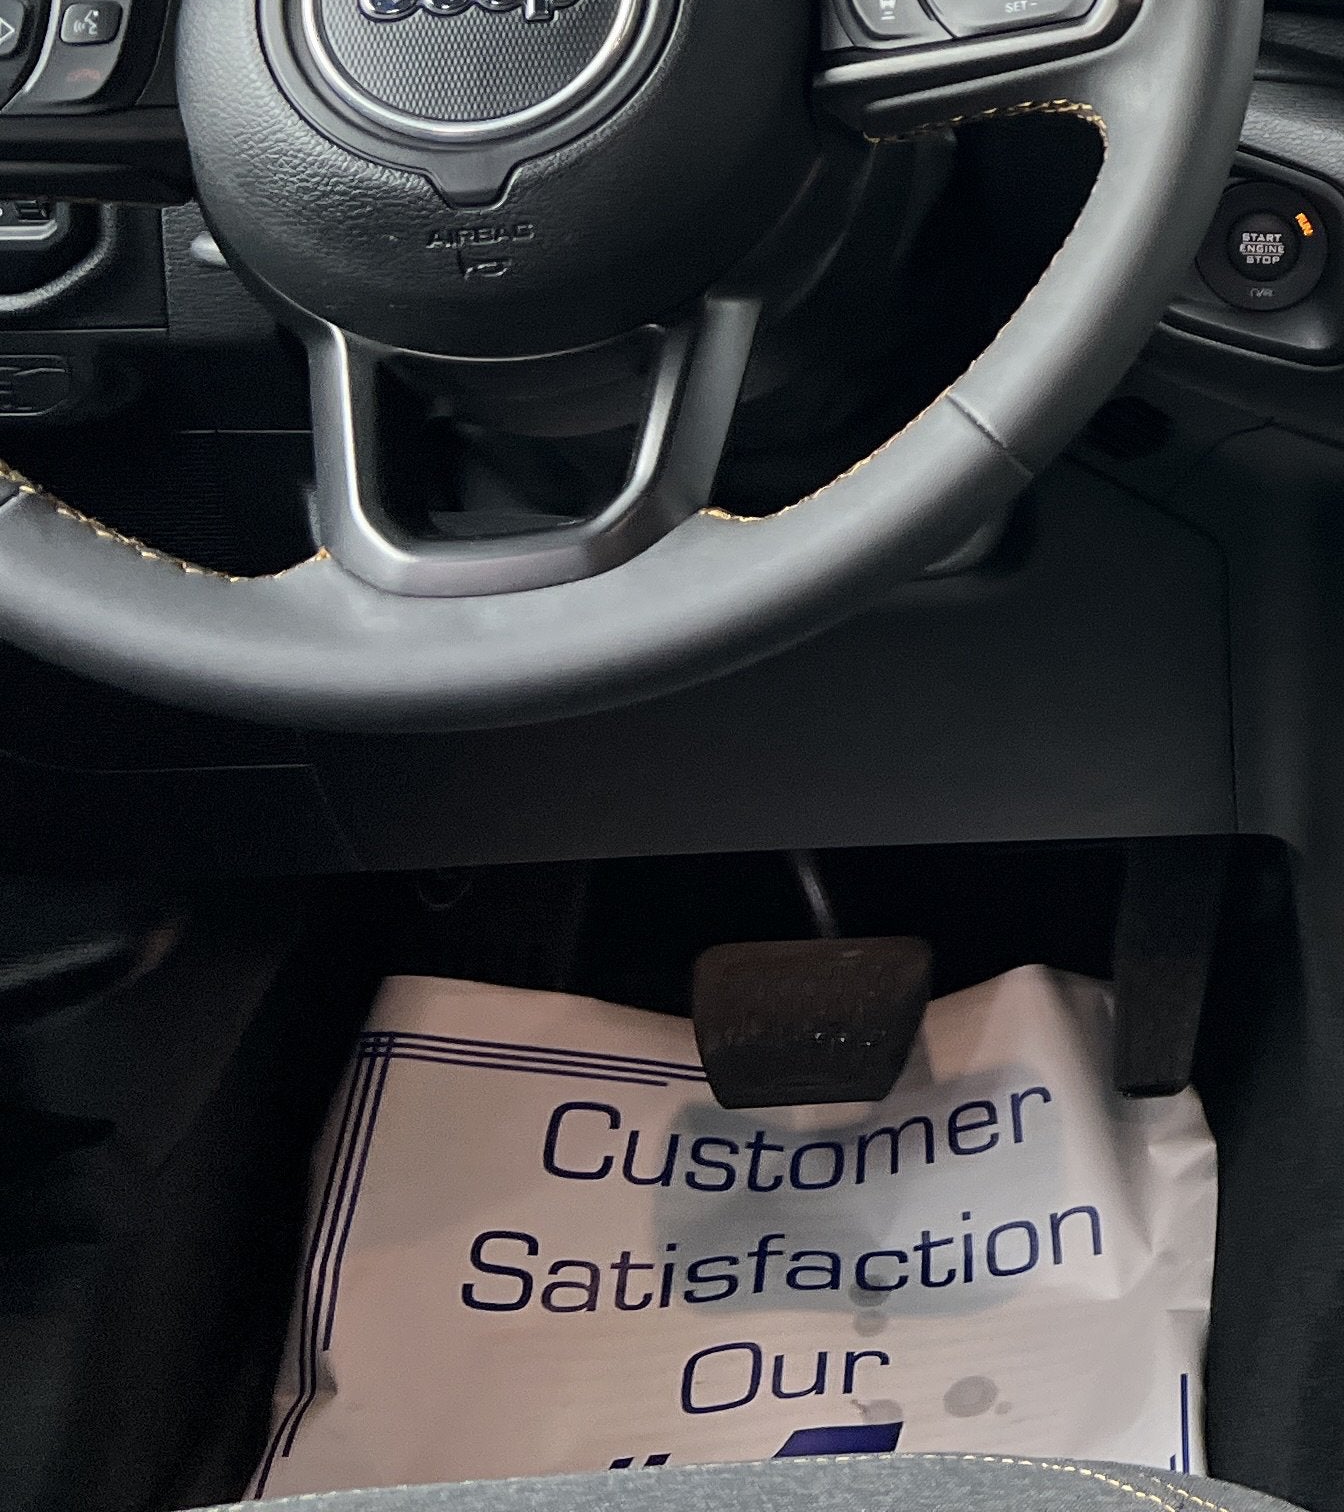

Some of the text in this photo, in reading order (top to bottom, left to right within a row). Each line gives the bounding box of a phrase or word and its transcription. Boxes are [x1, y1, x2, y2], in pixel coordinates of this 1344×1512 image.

[1239, 243, 1286, 254] ENGINE
[1241, 232, 1283, 243] START
[1245, 255, 1281, 265] STOP
[542, 1084, 1053, 1194] Customer
[460, 1203, 1104, 1313] Satisfaction
[680, 1341, 891, 1415] Our
